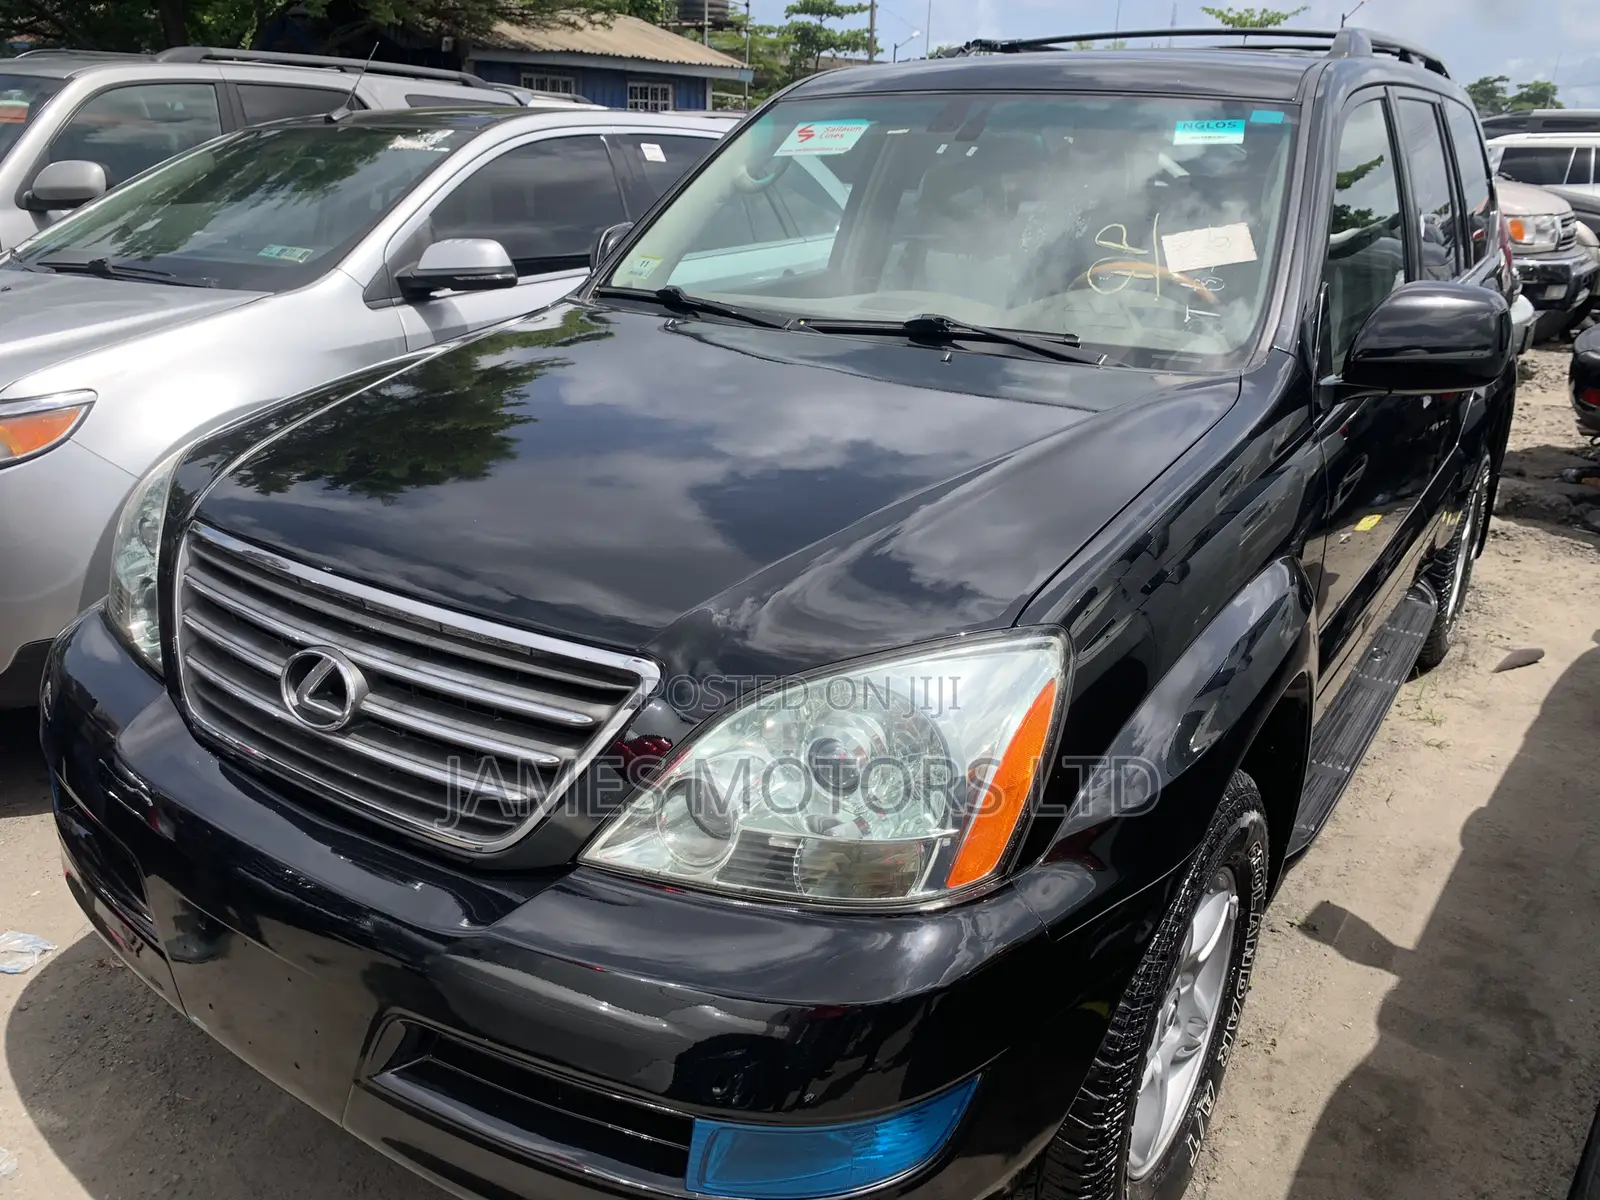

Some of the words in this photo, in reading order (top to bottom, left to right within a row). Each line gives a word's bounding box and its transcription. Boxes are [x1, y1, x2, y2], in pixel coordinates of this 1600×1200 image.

[1182, 121, 1237, 130] NGLOS
[1216, 839, 1267, 1067] GEOLANDAR
[1187, 1079, 1217, 1168] A/T
